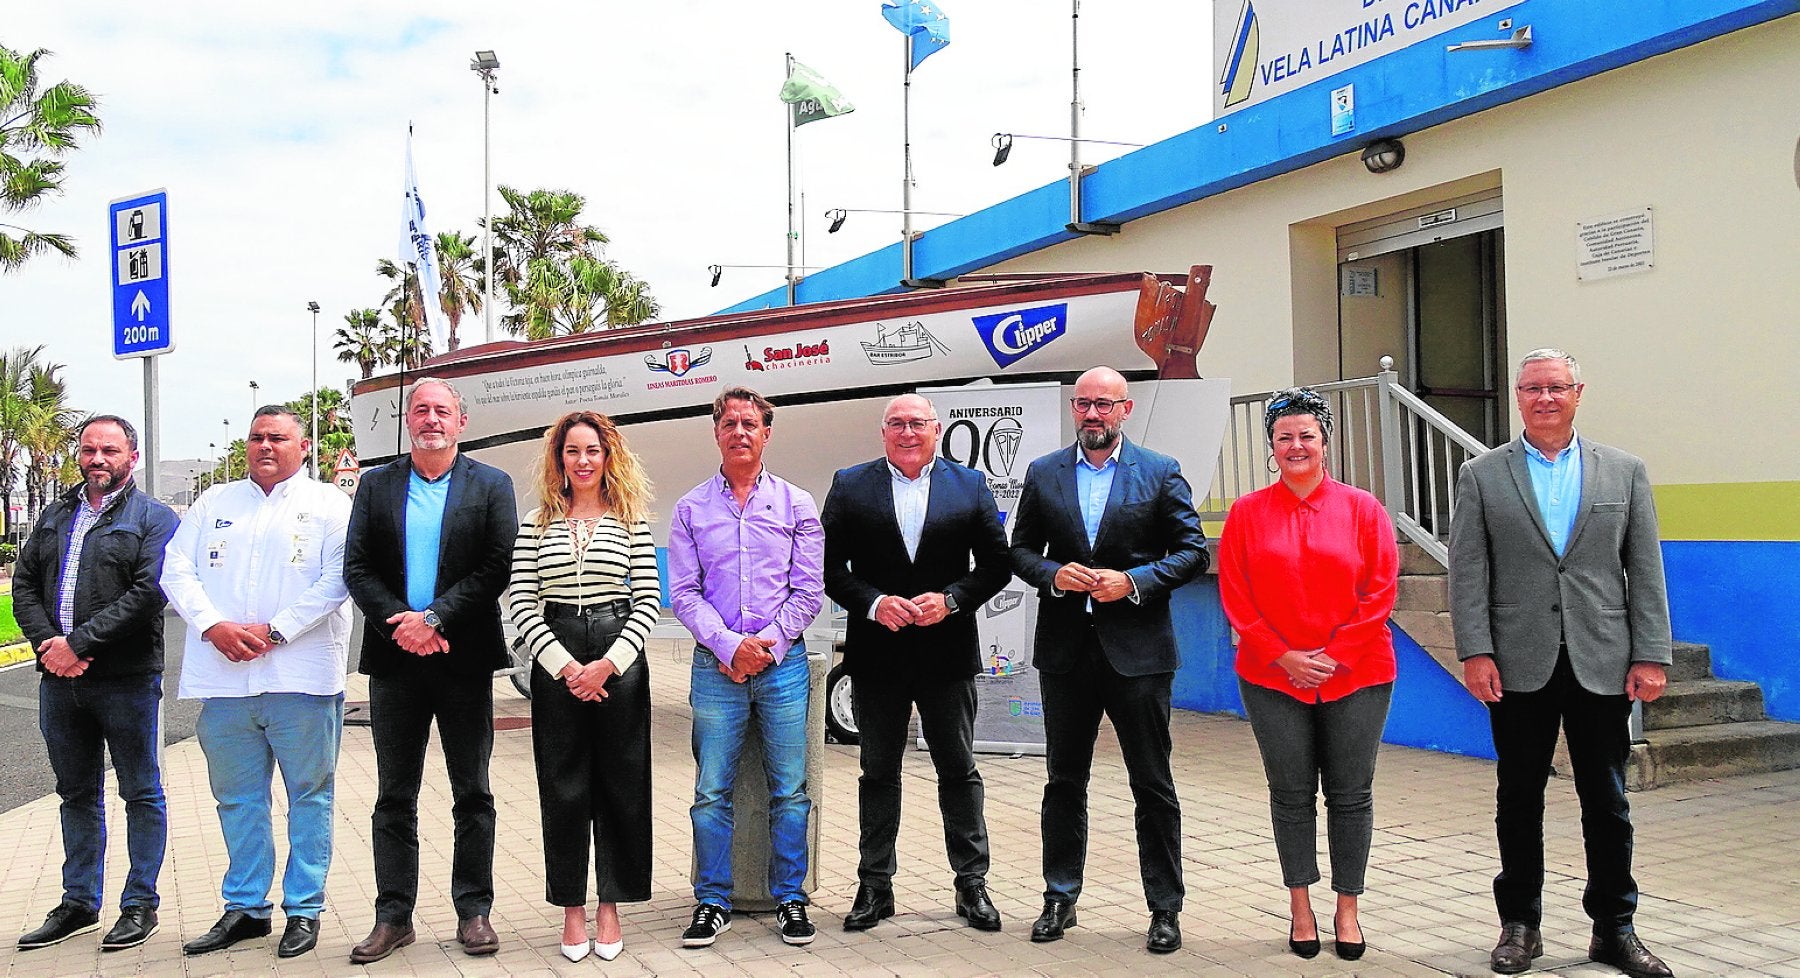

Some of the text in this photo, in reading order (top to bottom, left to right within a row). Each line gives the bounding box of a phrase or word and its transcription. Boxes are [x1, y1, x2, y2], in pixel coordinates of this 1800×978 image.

[1261, 0, 1480, 86] VELA LATINA CANA
[992, 314, 1058, 356] Clipper
[764, 339, 830, 362] San José
[694, 375, 718, 385] ROMERO
[949, 406, 1023, 419] ANIVERSARIO
[340, 479, 354, 487] 20
[984, 592, 1019, 613] Clipper
